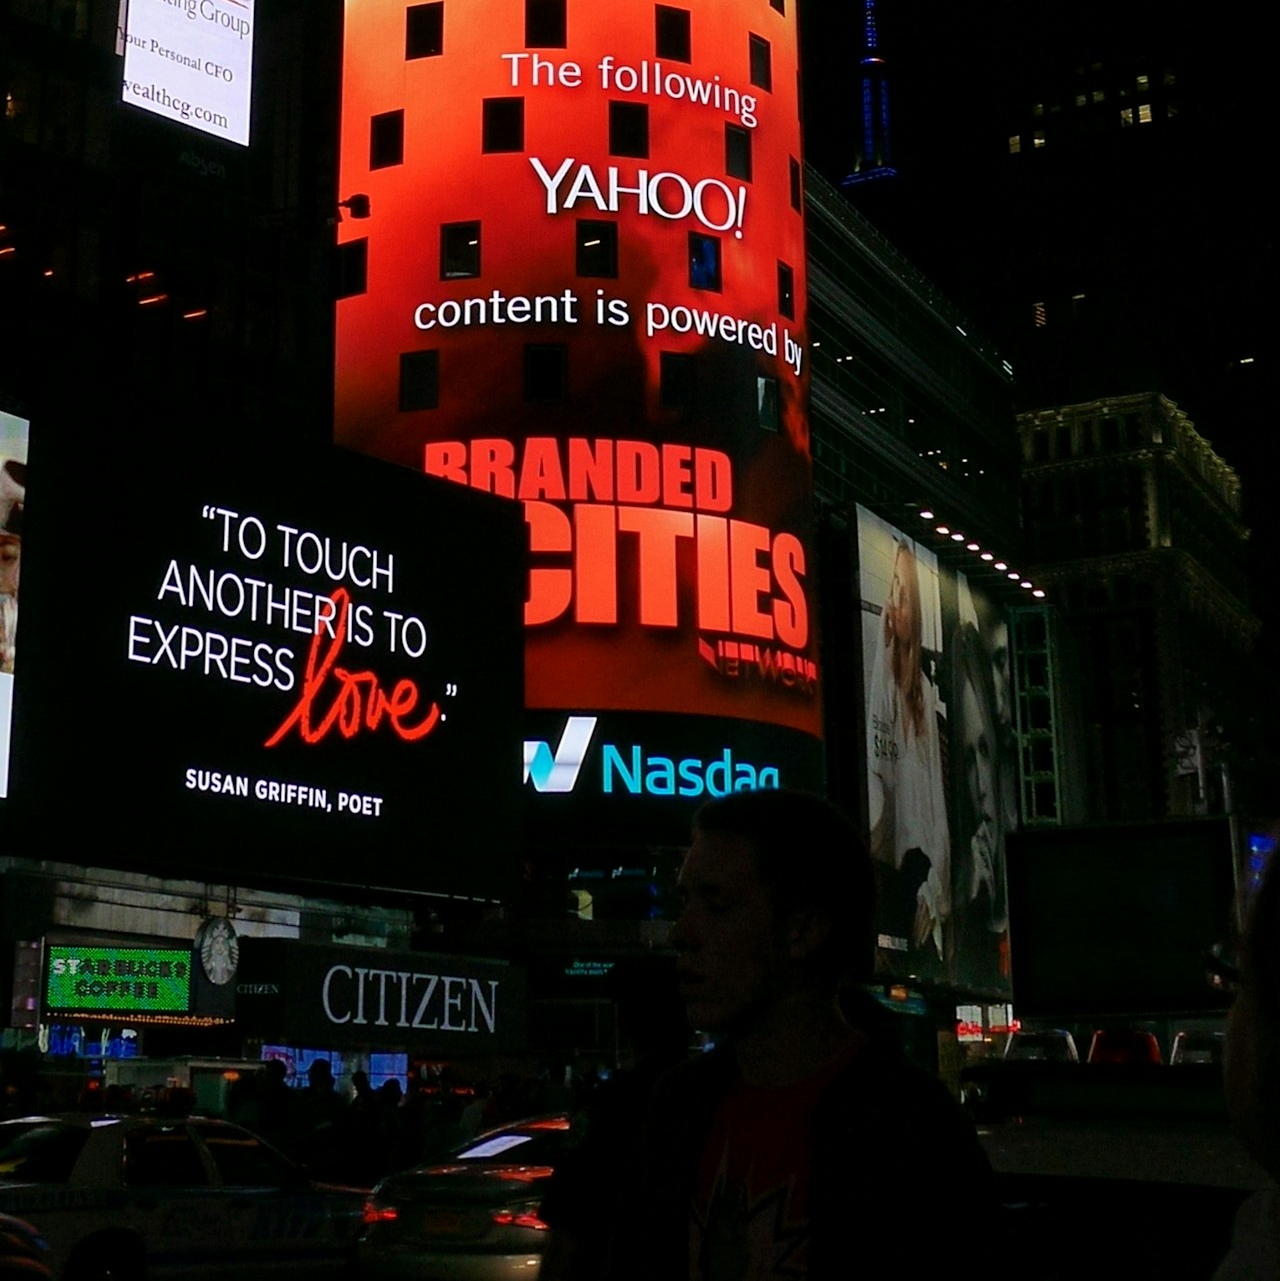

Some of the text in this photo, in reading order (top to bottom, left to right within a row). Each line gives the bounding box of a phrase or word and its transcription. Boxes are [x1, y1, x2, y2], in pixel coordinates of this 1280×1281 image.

[200, 0, 250, 40] Group
[151, 39, 200, 70] Personal
[205, 62, 233, 83] CFO
[501, 53, 758, 128] The following
[529, 157, 746, 239] YAHOO!
[414, 289, 802, 375] content is powered by
[425, 437, 732, 512] BRANDED
[277, 524, 394, 593] TOUCH
[524, 499, 808, 649] CITIES
[157, 559, 426, 657] ANOTHER IS TO
[128, 616, 295, 691] EXPRESS
[185, 768, 383, 817] SUSAN GRIFFIN, POET
[54, 959, 185, 977] STARBUCKS
[76, 982, 159, 998] COFFEE
[236, 983, 279, 995] CITIZEN
[321, 962, 500, 1034] CITIZEN
